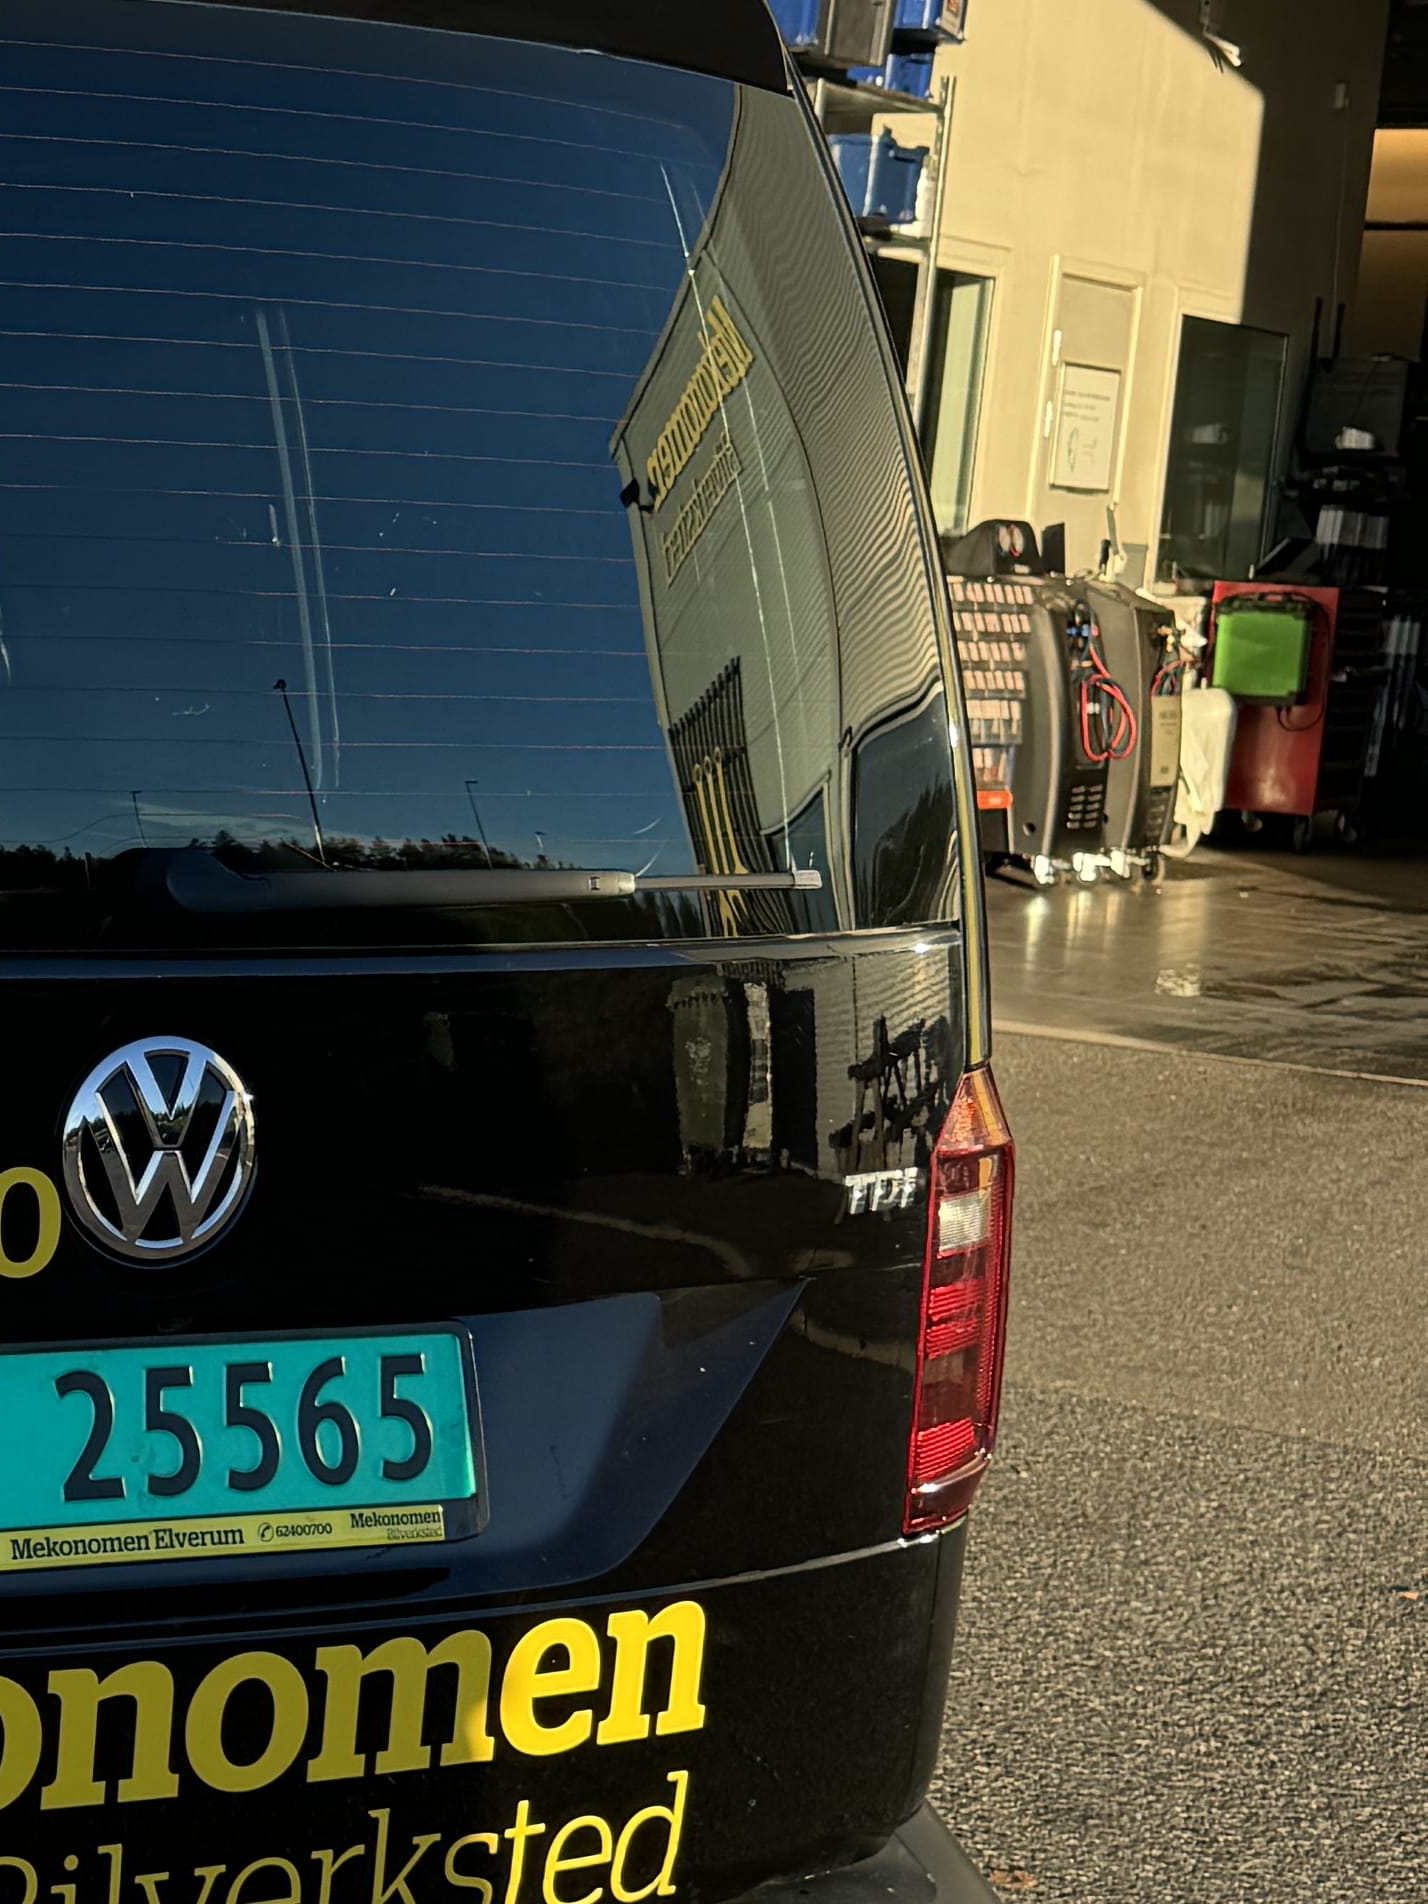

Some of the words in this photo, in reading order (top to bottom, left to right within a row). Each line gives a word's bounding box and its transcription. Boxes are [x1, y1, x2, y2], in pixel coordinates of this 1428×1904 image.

[54, 1351, 434, 1504] 25565
[275, 1522, 333, 1538] 62400700
[349, 1510, 441, 1529] Mekonomen
[10, 1532, 151, 1561] Mekonomen
[153, 1527, 245, 1550] Elverum
